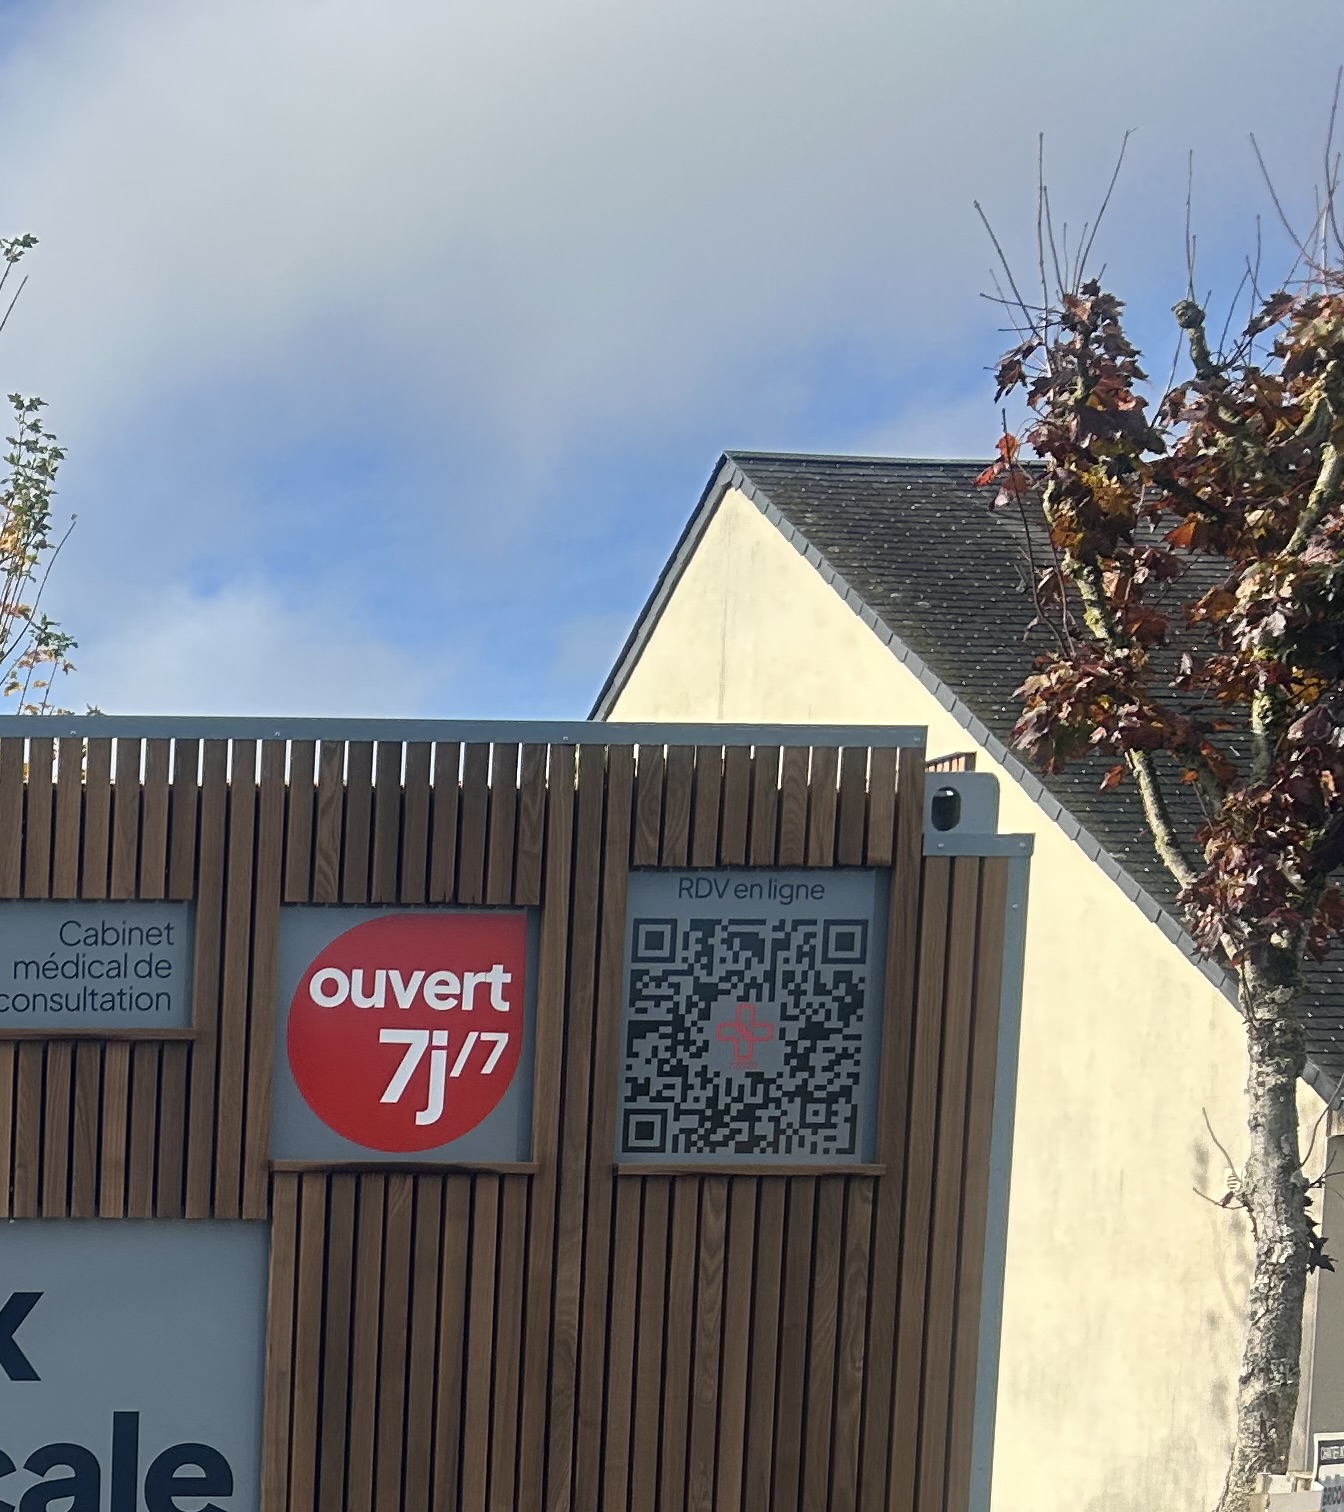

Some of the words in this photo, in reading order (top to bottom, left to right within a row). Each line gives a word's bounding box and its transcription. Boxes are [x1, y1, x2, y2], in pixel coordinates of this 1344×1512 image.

[678, 877, 730, 899] RDV
[734, 882, 762, 899] en
[768, 878, 825, 905] ligne
[59, 920, 174, 947] Cabinet
[13, 952, 132, 980] médical
[135, 953, 172, 980] de
[309, 964, 512, 1012] ouvert
[378, 1028, 508, 1126] 7j/7
